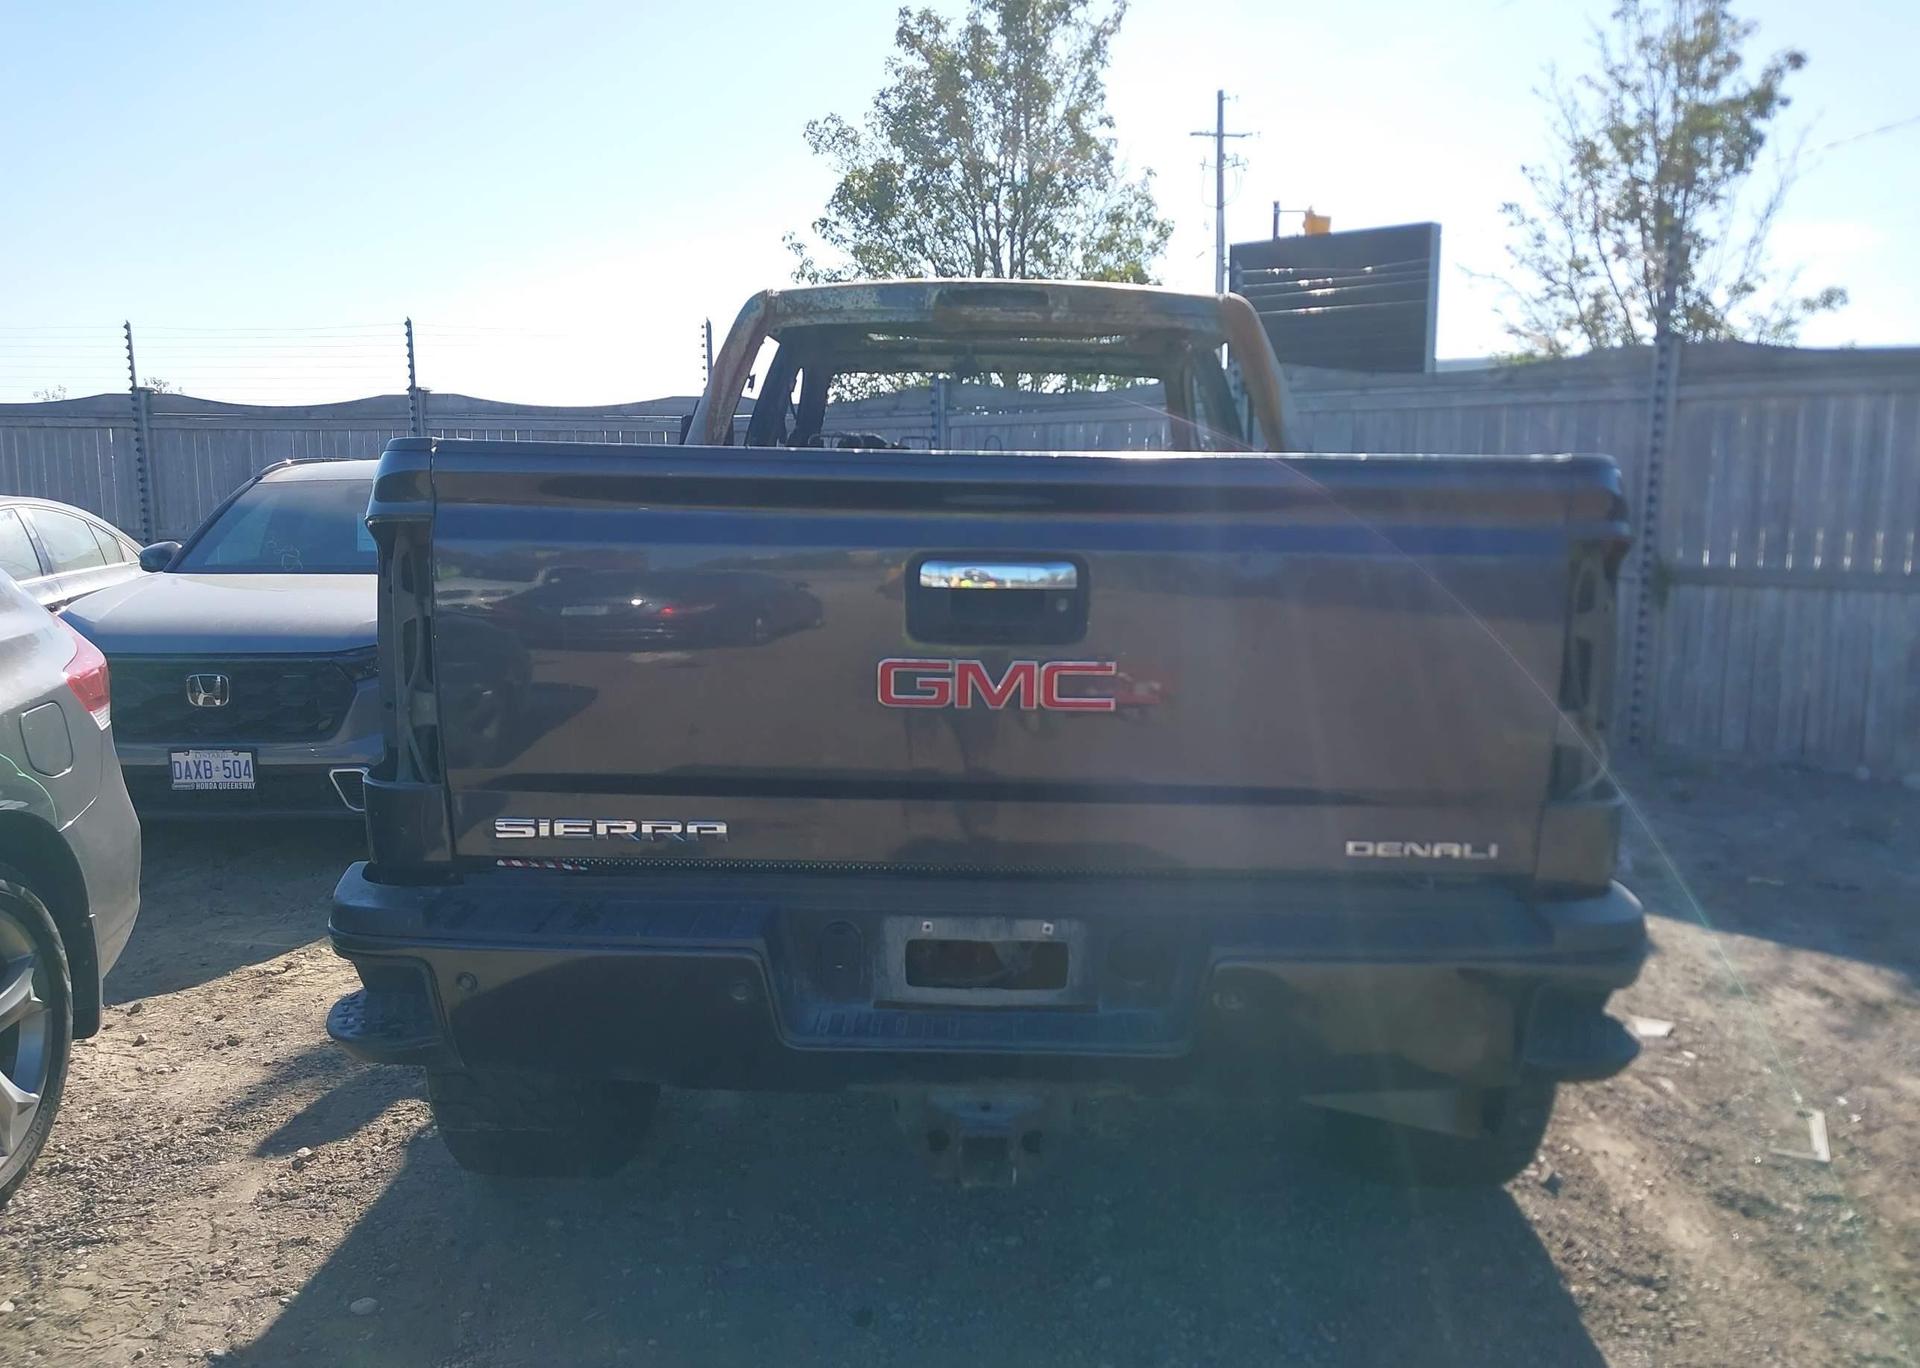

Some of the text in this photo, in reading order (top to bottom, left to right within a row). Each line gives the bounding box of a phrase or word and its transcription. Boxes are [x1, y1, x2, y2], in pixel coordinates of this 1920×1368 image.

[878, 658, 1117, 711] GMC
[218, 782, 256, 790] QUEENSWAY
[494, 818, 728, 841] SIERRA
[1345, 840, 1499, 859] DENALI
